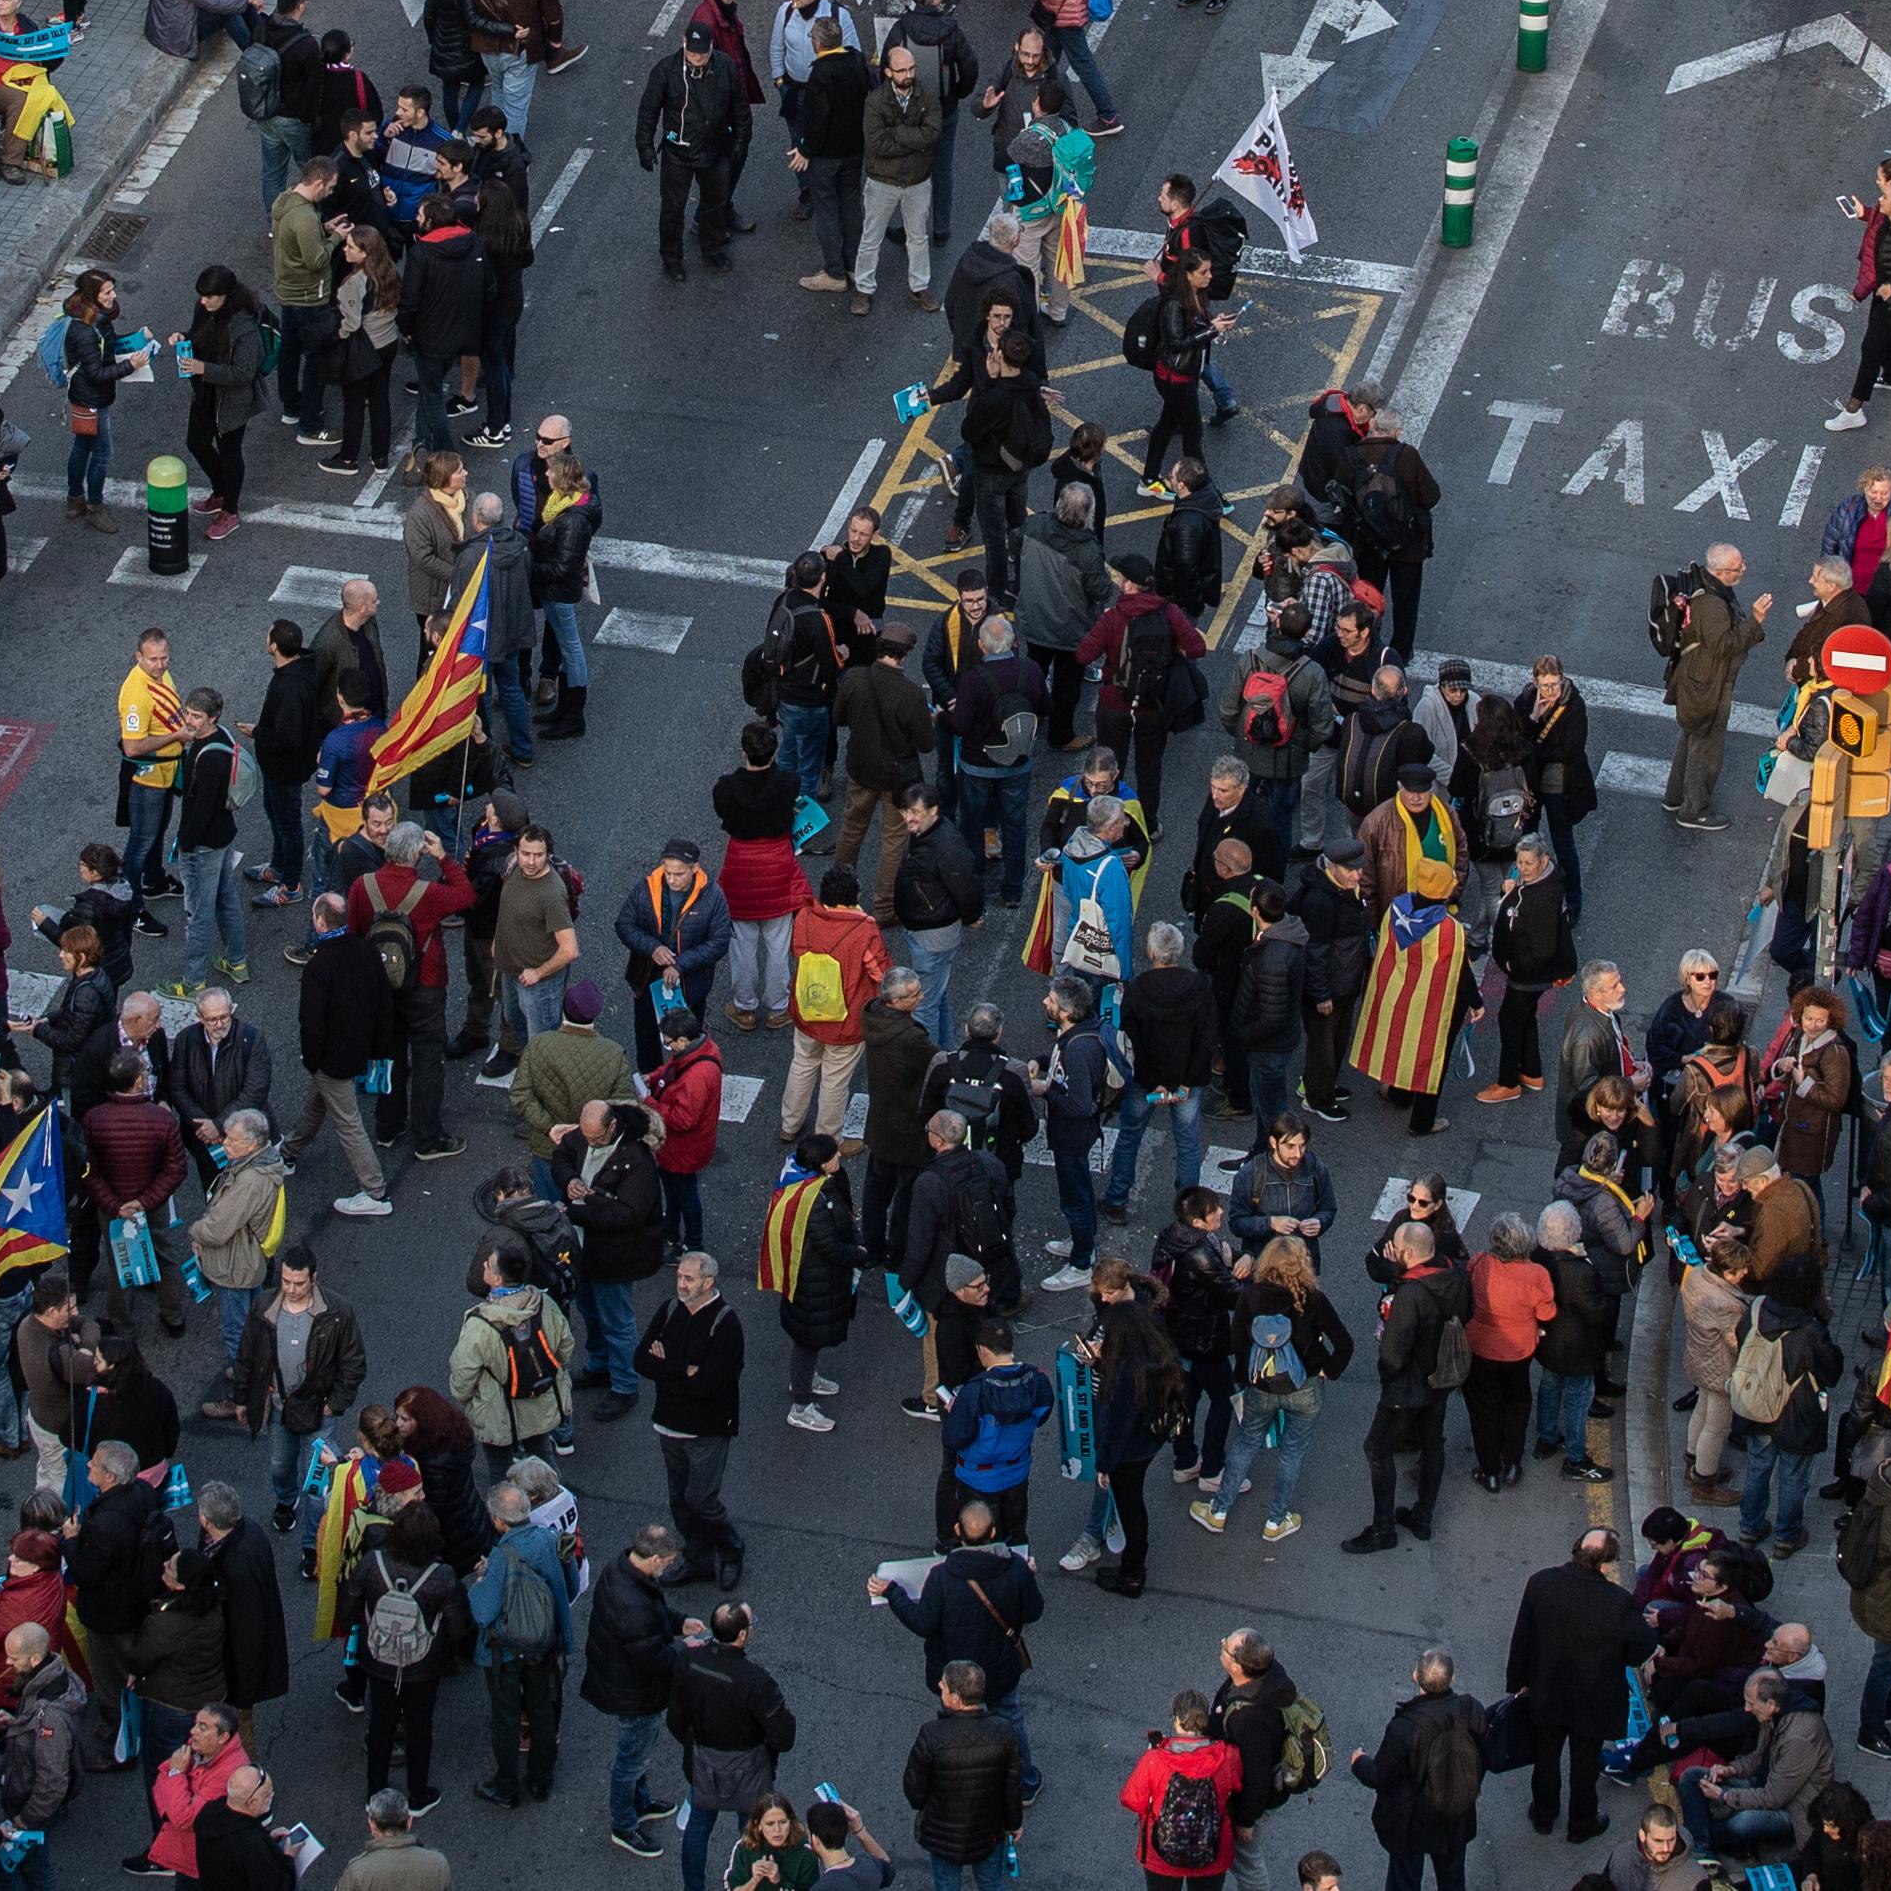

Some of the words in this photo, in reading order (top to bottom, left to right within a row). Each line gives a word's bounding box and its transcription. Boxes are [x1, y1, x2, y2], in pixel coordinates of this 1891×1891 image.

[23, 34, 36, 46] SIT
[36, 31, 50, 44] AND
[1600, 259, 1855, 365] BUS
[1486, 399, 1827, 529] TAXI
[1078, 1409, 1089, 1429] AND
